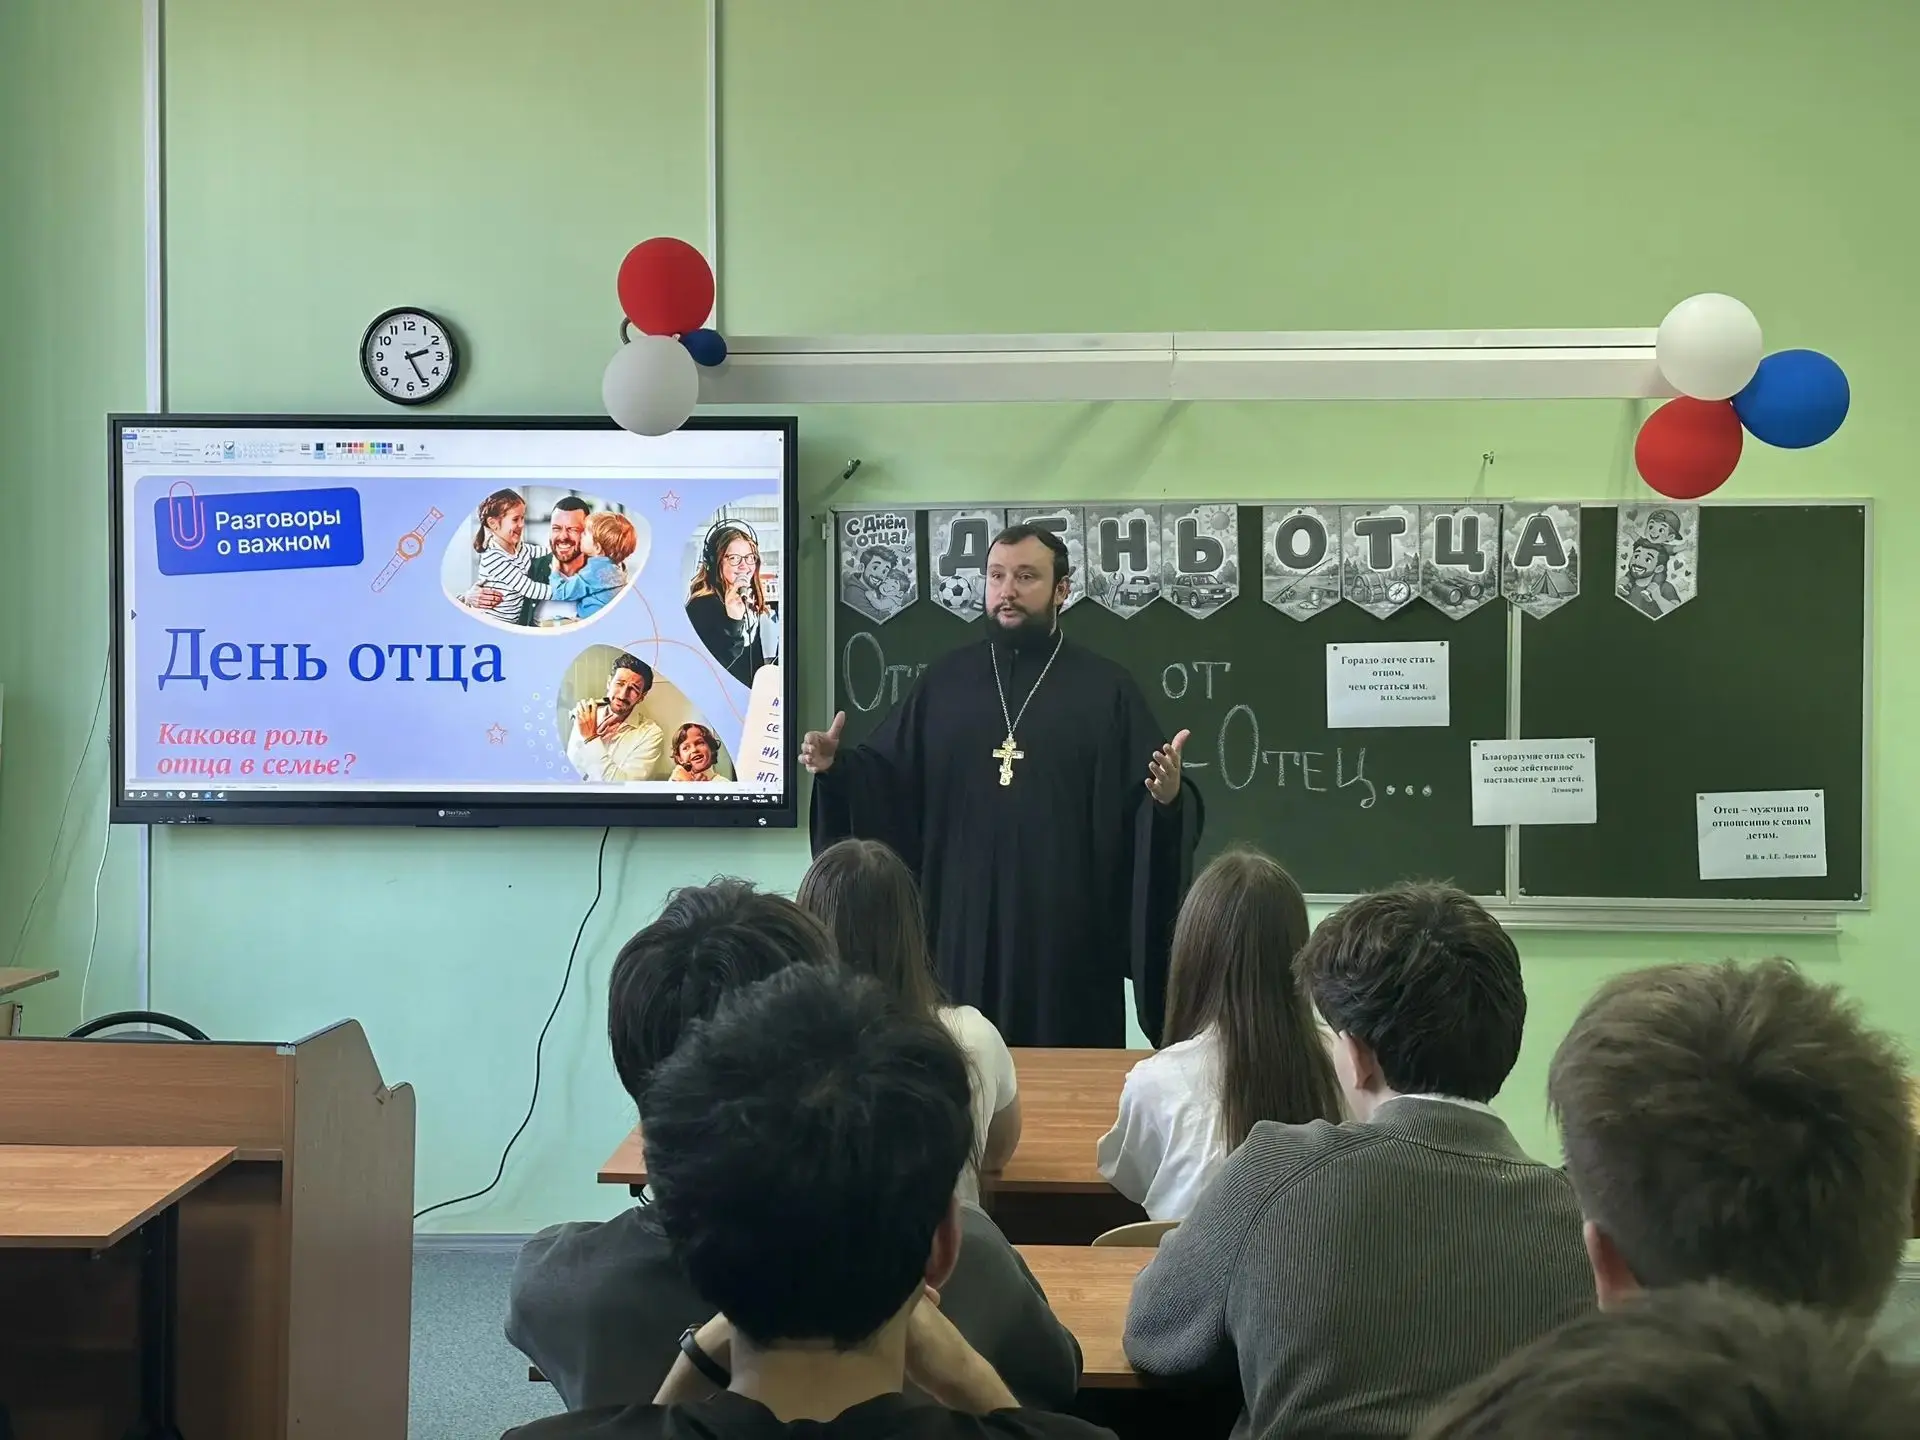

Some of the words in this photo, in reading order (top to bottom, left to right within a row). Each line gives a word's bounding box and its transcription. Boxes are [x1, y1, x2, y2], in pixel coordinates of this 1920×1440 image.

[390, 325, 398, 335] 11
[403, 321, 415, 331] 12
[423, 326, 427, 336] 1
[379, 336, 391, 346] 10
[431, 336, 440, 345] 2
[376, 352, 384, 361] 9
[436, 352, 444, 361] 3
[380, 367, 388, 376] 8
[431, 367, 440, 376] 4
[391, 378, 399, 388] 7
[407, 382, 414, 391] 6
[422, 378, 430, 387] 5
[215, 508, 341, 531] Разговоры
[846, 519, 860, 536] С
[862, 513, 907, 534] Днём
[856, 530, 908, 548] отца!
[217, 541, 232, 556] о
[238, 534, 331, 554] важном
[158, 628, 327, 691] День
[348, 642, 506, 692] отца
[1341, 656, 1379, 666] Гораздо
[1381, 657, 1407, 665] легче
[1409, 656, 1435, 664] стать
[157, 722, 256, 746] Какова
[264, 728, 328, 751] роль
[1482, 752, 1542, 762] Благоразумие
[1566, 752, 1586, 760] есть
[157, 756, 232, 779] отца
[240, 757, 254, 775] в
[262, 753, 357, 775] семье?
[1520, 764, 1574, 772] действенное
[1484, 776, 1538, 784] наставление
[1714, 806, 1739, 814] Отец
[1750, 806, 1795, 816] мужчина
[1712, 820, 1770, 828] отношению
[1781, 818, 1811, 826] своим
[1746, 832, 1778, 840] детям.
